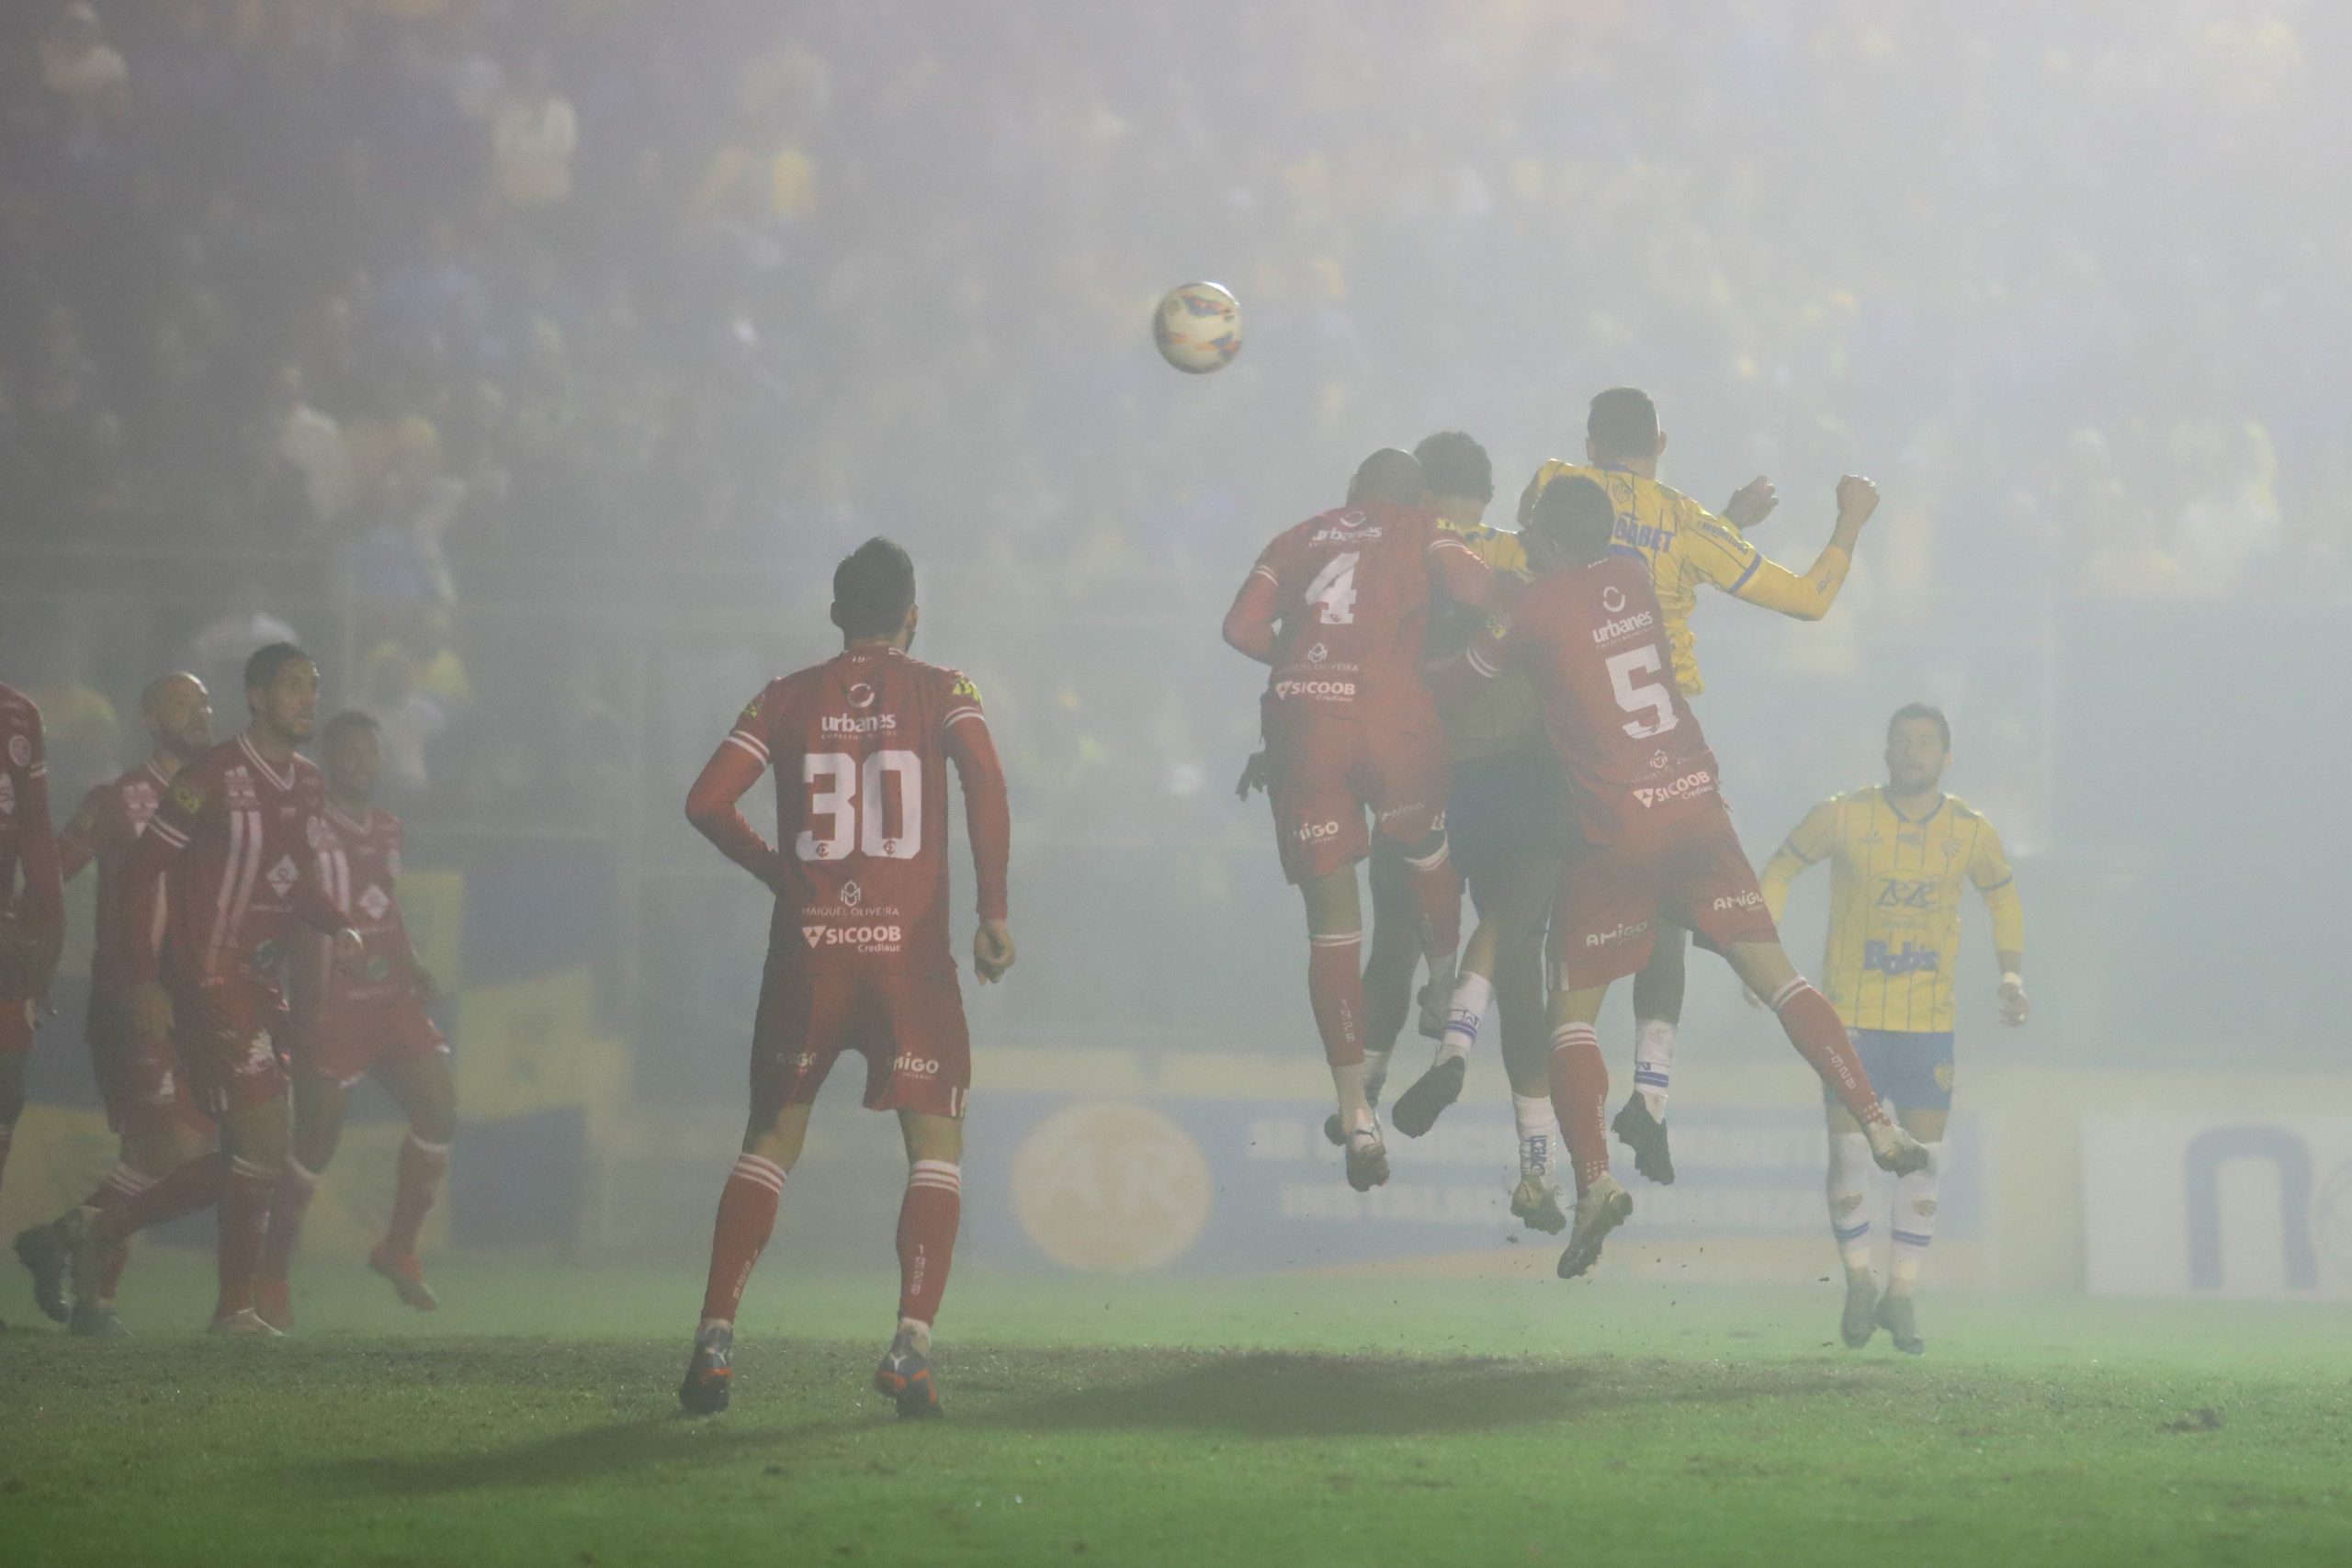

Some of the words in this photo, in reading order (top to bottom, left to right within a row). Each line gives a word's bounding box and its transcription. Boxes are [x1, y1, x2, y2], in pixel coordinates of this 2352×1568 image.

[1305, 551, 1360, 625] 4
[1592, 610, 1653, 643] urbanes
[1291, 682, 1356, 695] SICOOB
[1605, 644, 1679, 739] 5
[820, 713, 897, 733] urbanes
[1655, 771, 1711, 802] SICOOB
[796, 750, 922, 861] 30
[850, 907, 899, 916] OLIVEIRA
[826, 925, 901, 944] SICOOB
